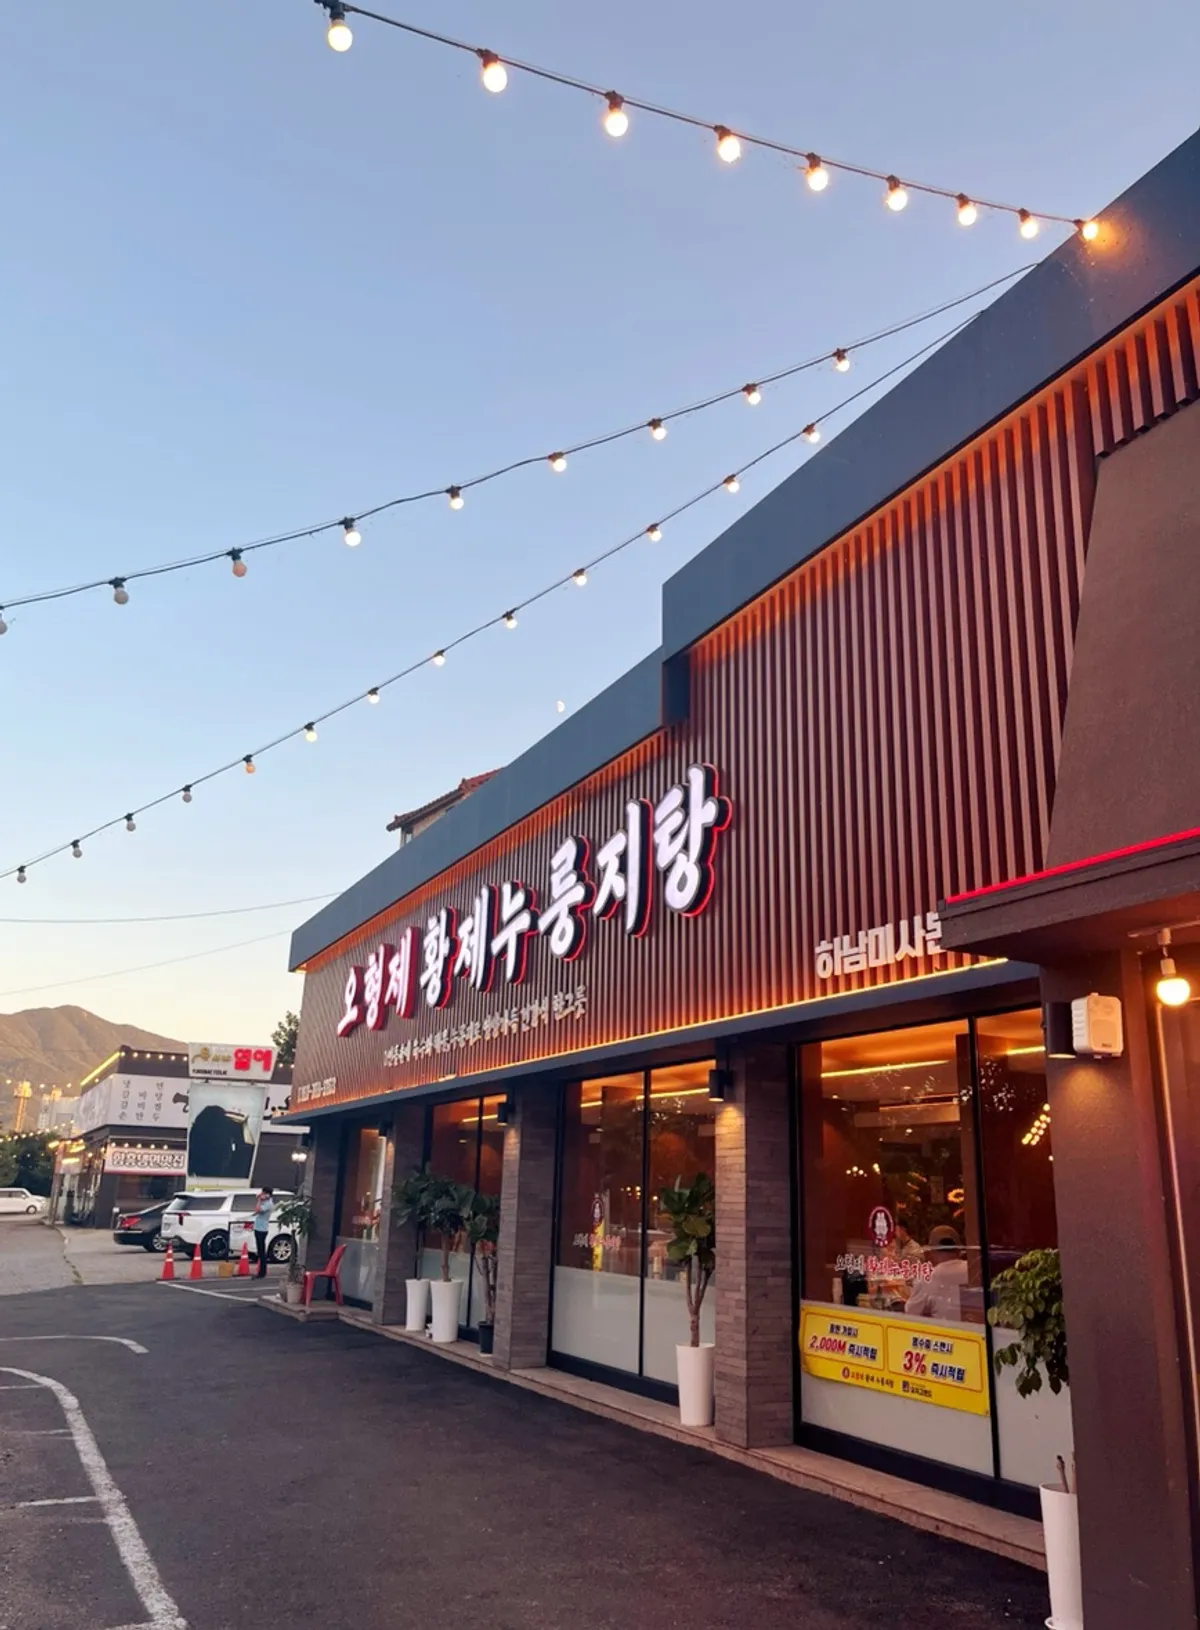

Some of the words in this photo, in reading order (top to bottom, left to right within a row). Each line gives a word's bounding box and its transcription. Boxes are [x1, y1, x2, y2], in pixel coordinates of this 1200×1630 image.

[337, 926, 419, 1037] 오형제
[420, 764, 728, 1007] 황제누룽지탕
[809, 1335, 847, 1354] 2,000M
[903, 1350, 928, 1375] 3%
[931, 1363, 965, 1381] 즉시적립
